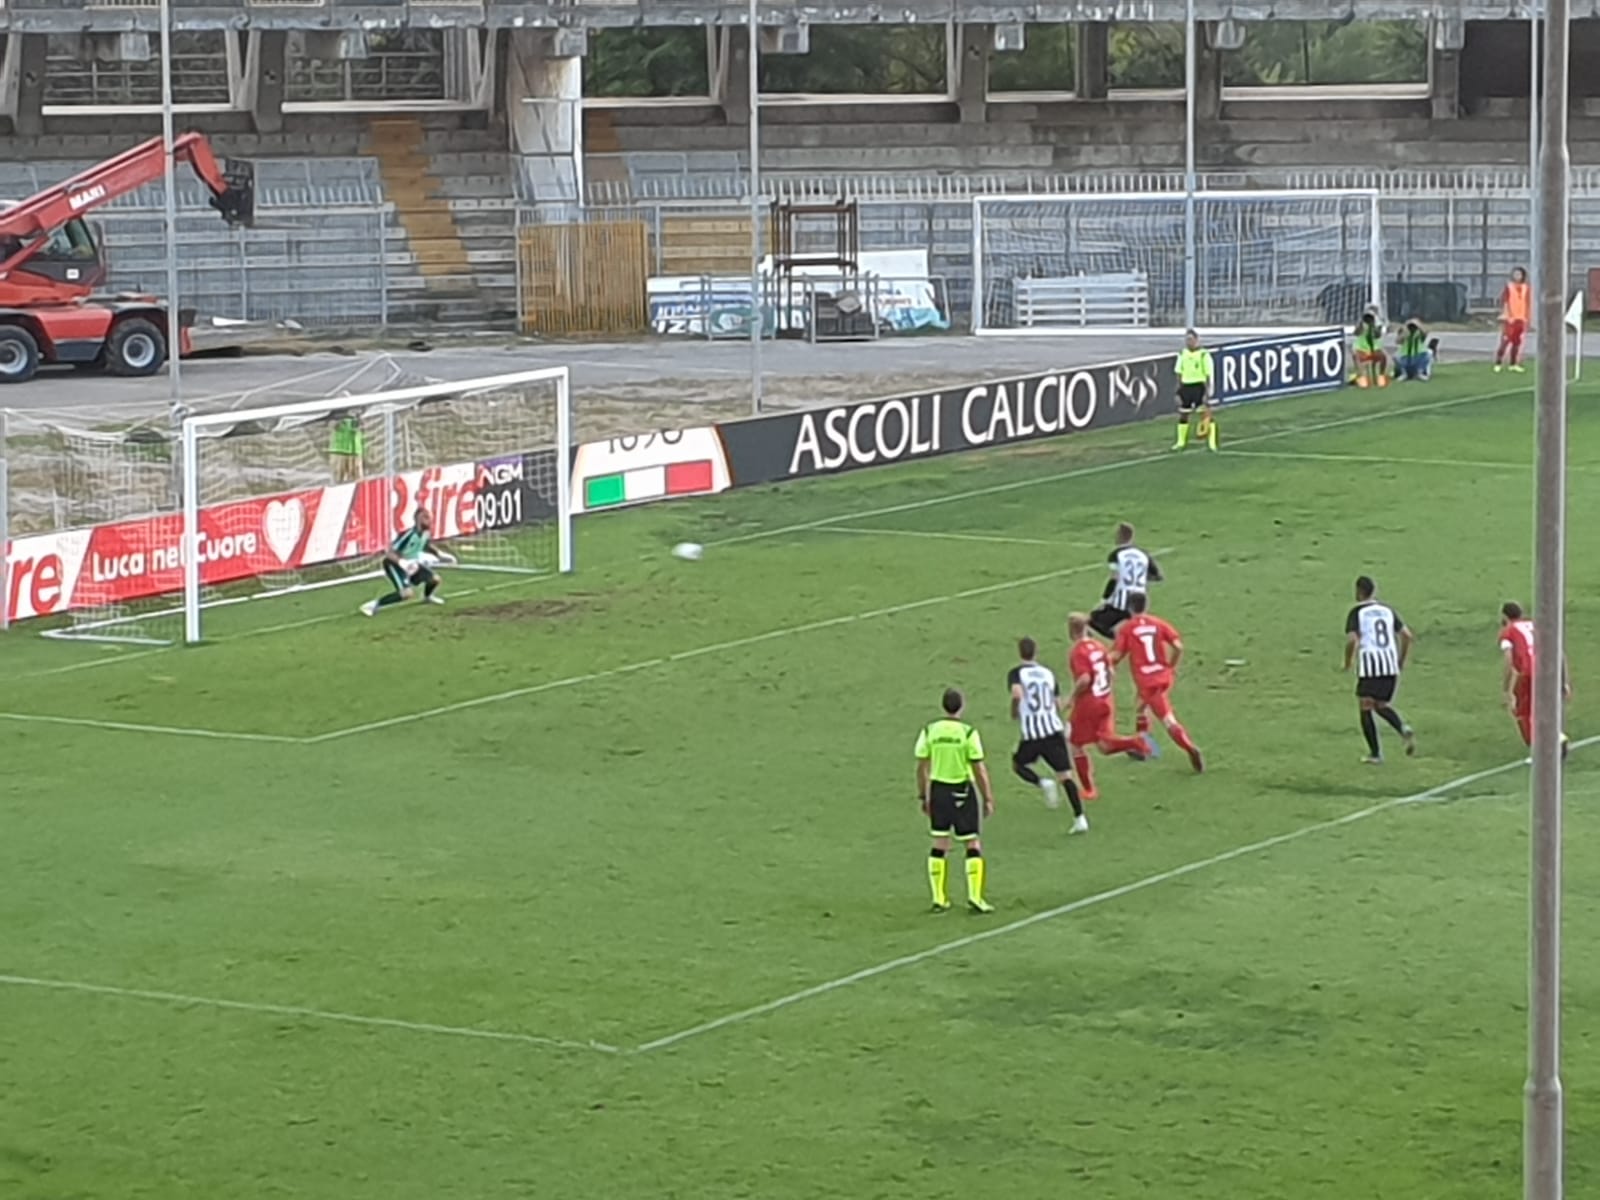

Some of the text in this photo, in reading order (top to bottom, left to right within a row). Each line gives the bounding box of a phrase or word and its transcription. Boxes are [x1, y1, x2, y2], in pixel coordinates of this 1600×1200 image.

[1223, 338, 1343, 392] RISPETTO
[789, 394, 941, 474] ASCOLI
[961, 371, 1098, 445] CALCIO
[475, 488, 521, 529] 09:01
[92, 552, 145, 582] Luca
[197, 531, 257, 564] Cuore
[1124, 559, 1147, 587] 32
[1027, 681, 1053, 712] 30
